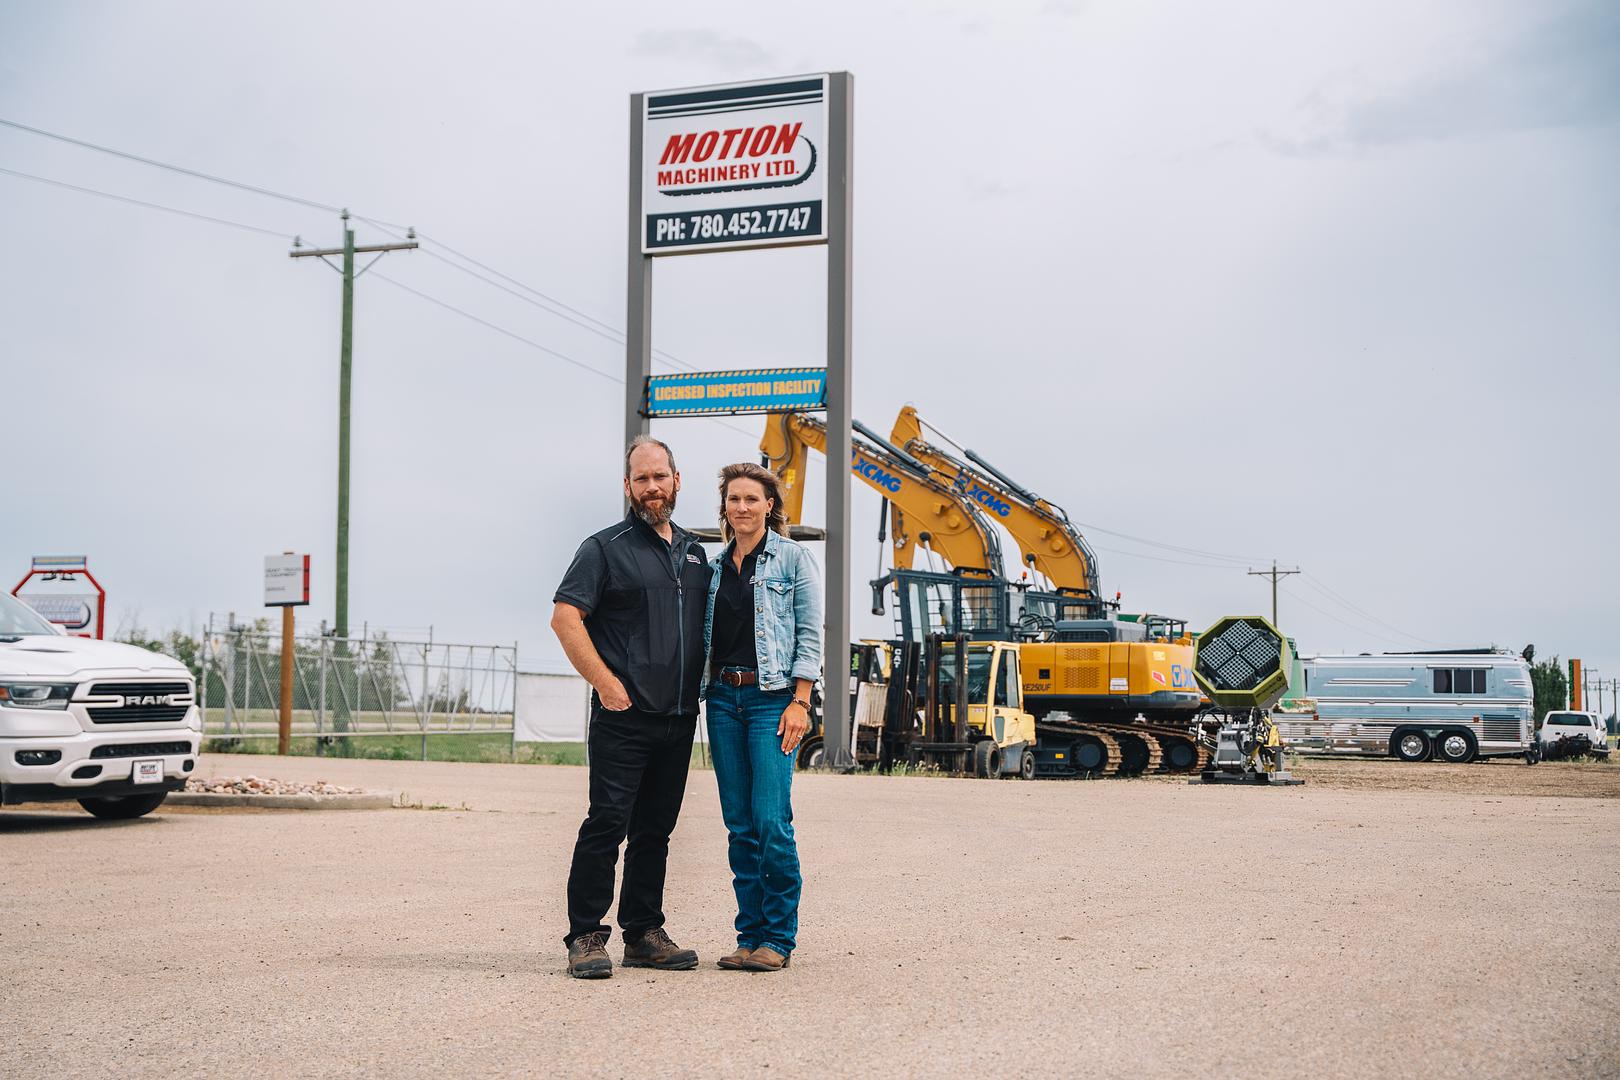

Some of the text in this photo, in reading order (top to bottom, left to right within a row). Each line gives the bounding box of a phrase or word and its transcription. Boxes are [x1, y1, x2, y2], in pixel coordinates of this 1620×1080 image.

[658, 122, 803, 165] MOTION
[657, 159, 800, 186] MACHINERY LTD.
[656, 206, 811, 241] PH: 780.452.7747
[655, 379, 821, 401] LICENSED INSPECTION FACILITY
[853, 457, 902, 493] XCMG
[967, 484, 1011, 517] XCMG
[894, 648, 902, 668] CAT
[126, 695, 169, 706] RAM
